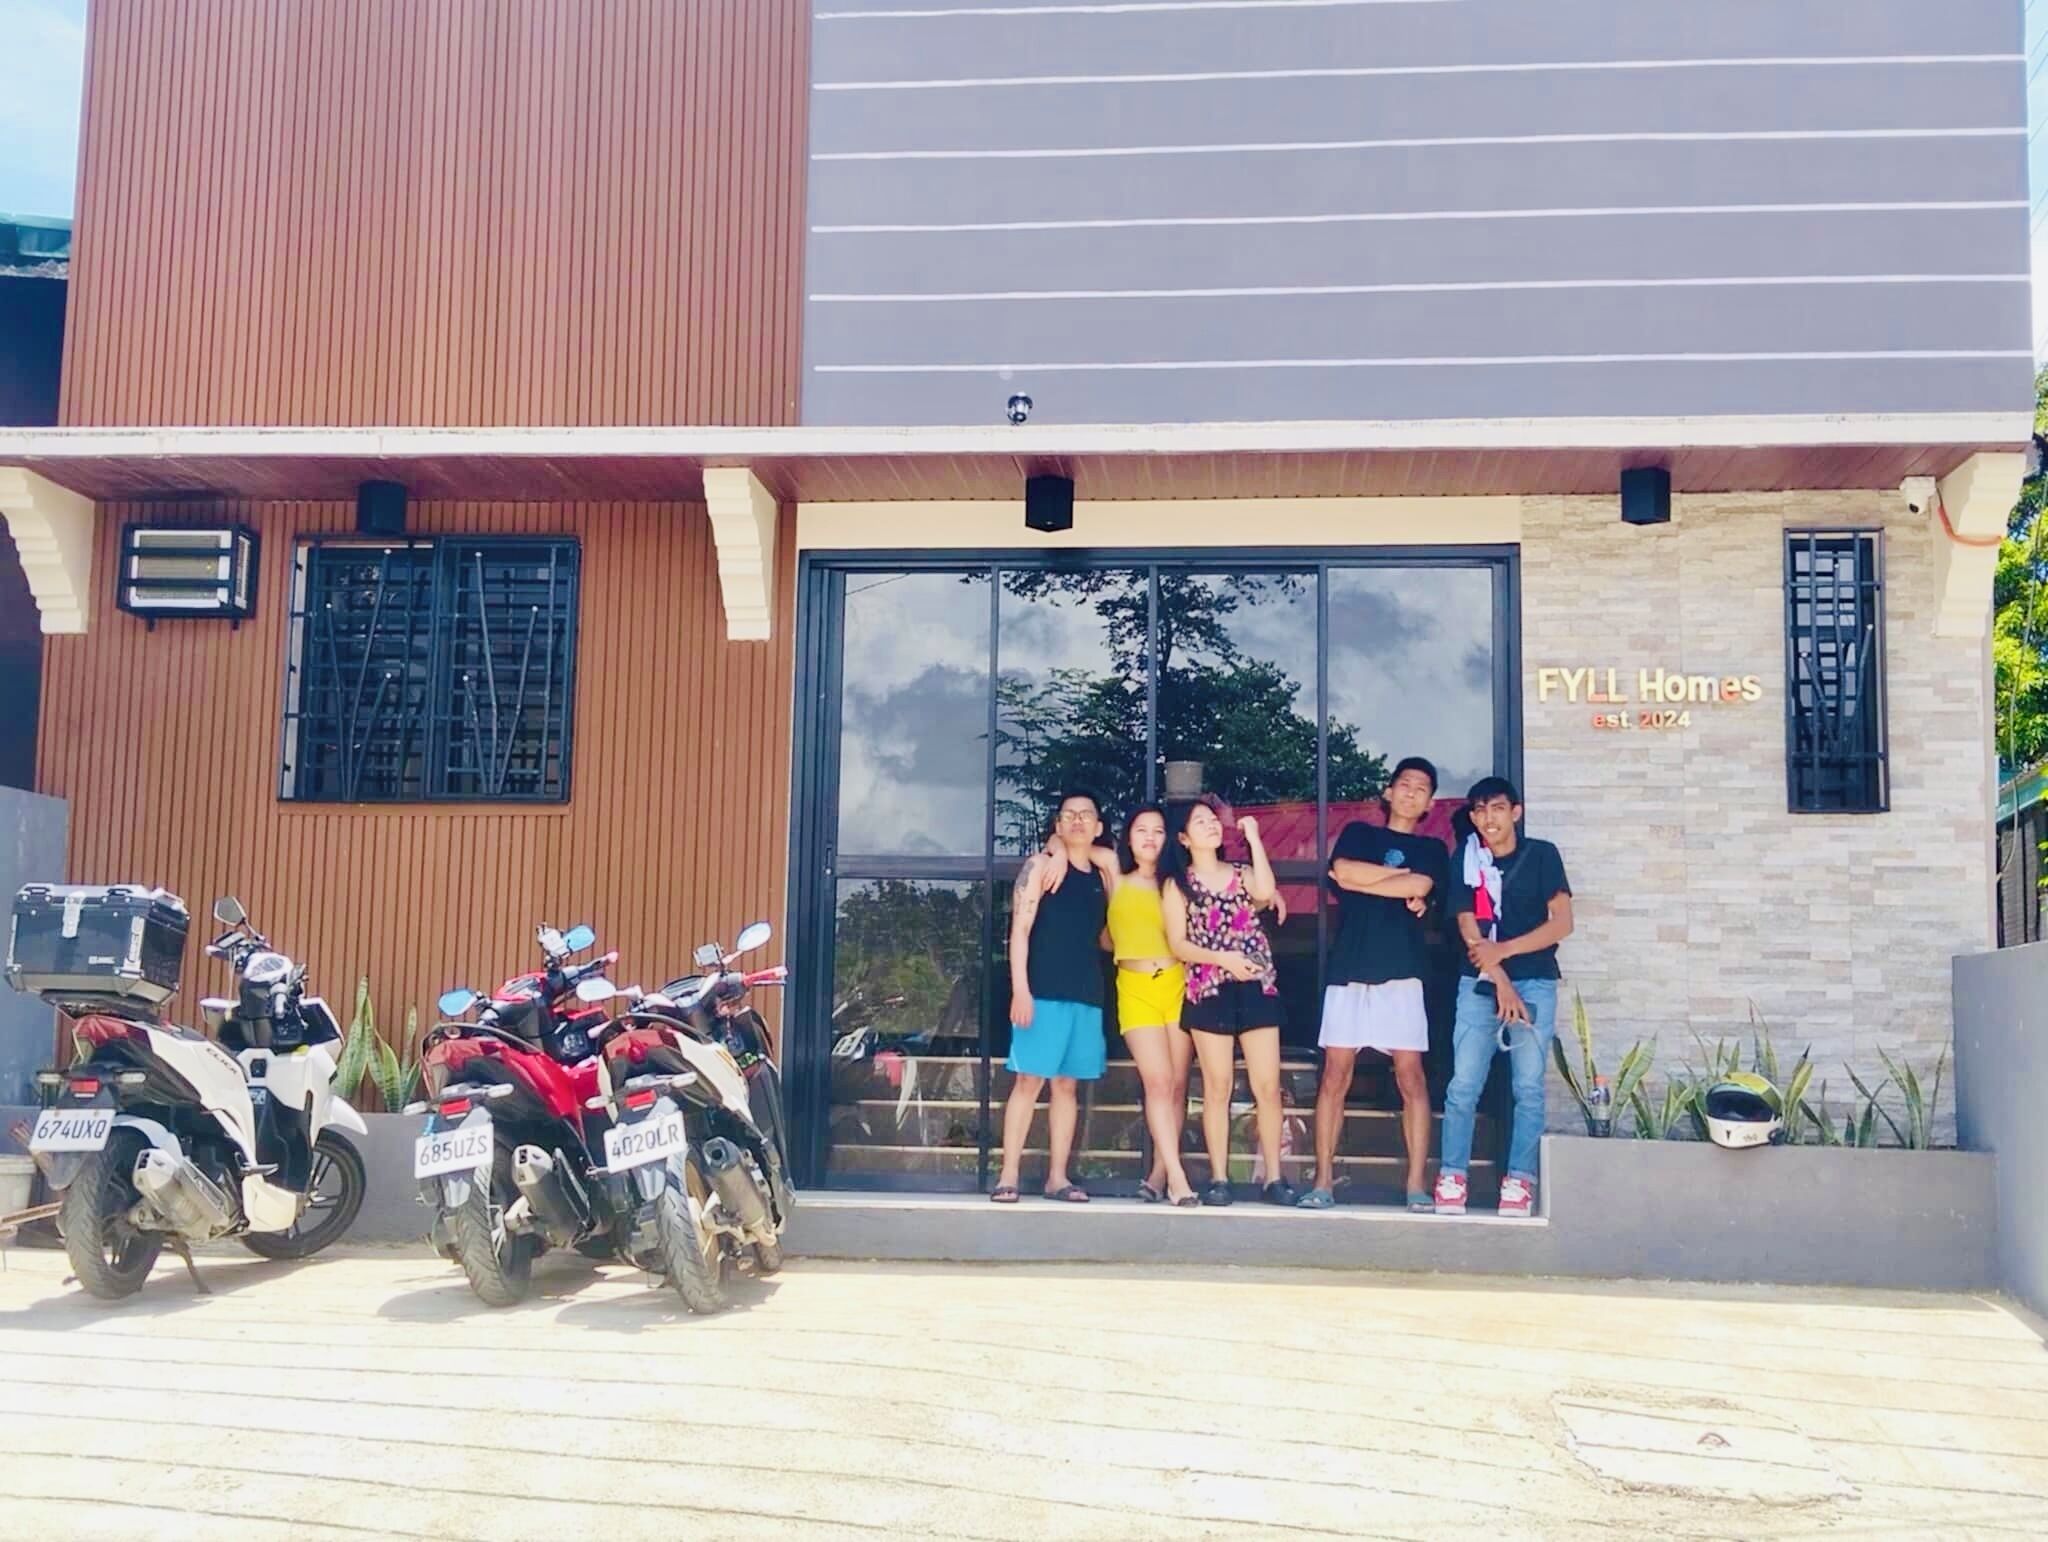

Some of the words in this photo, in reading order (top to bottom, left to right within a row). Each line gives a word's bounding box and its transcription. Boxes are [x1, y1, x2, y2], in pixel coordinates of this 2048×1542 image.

[1538, 667, 1628, 702] FYLL
[1639, 667, 1762, 702] Homes
[1639, 710, 1691, 728] 2024
[419, 1135, 488, 1167] 685UZS
